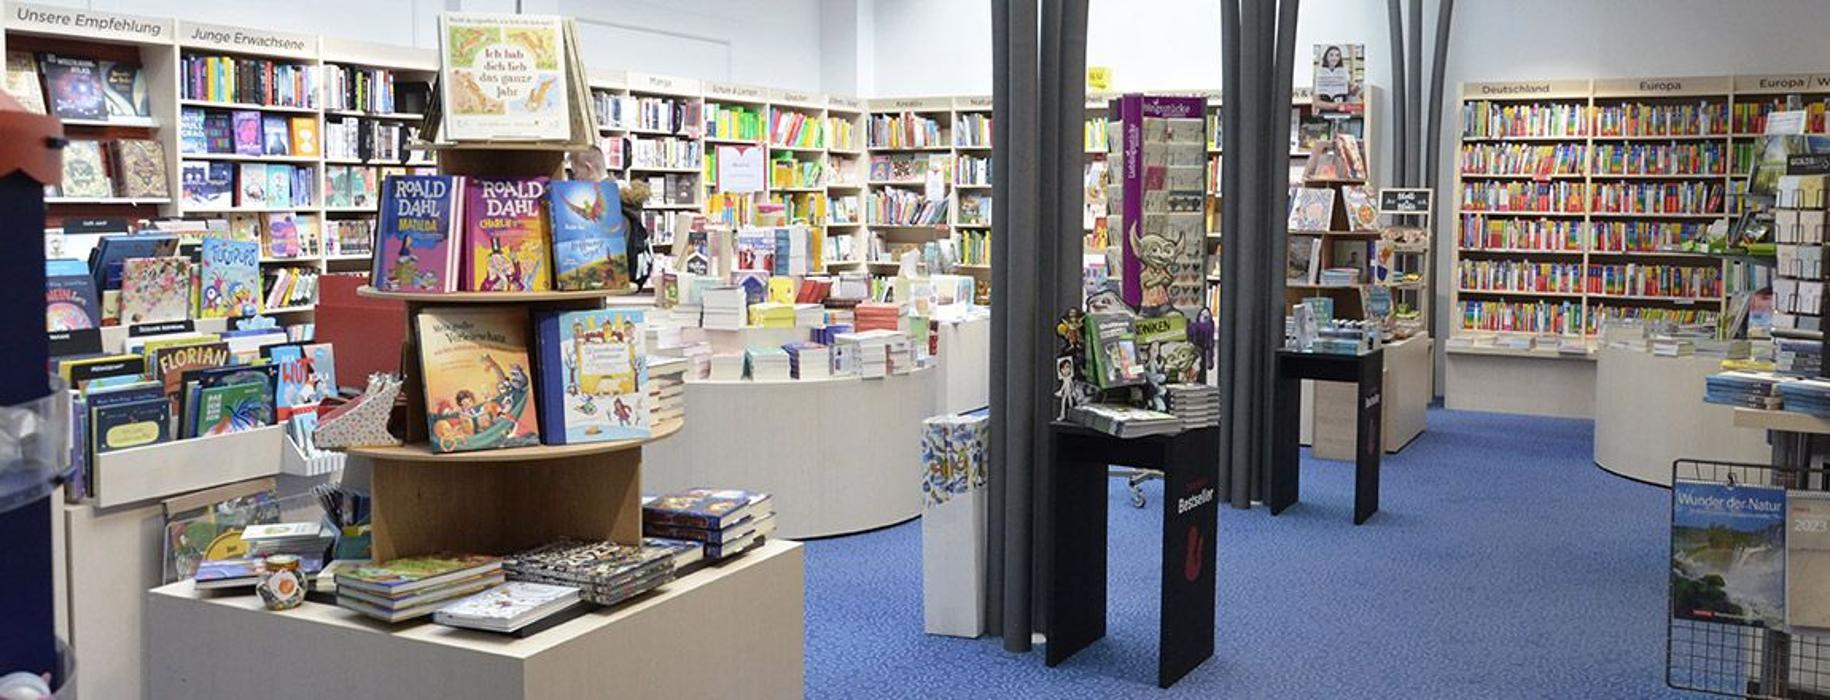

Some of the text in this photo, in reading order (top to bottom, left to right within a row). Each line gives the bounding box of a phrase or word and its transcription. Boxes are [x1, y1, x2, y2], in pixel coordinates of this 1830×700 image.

[17, 7, 162, 37] Unsere Empfehlung
[191, 28, 305, 50] Junge Erwachsene
[485, 48, 524, 59] Ich hab
[483, 61, 527, 71] dich lieb
[479, 72, 532, 85] das ganze
[1639, 80, 1682, 92] Europa
[1759, 77, 1804, 90] Europa
[496, 86, 518, 98] Jahr
[1481, 84, 1550, 95] Deutschland
[395, 180, 446, 199] ROALD
[482, 180, 544, 199] ROALD
[397, 199, 441, 217] DAHL
[487, 199, 539, 217] DAHL
[159, 346, 228, 374] FLORIAN
[1178, 488, 1214, 515] Bestseller
[1678, 492, 1724, 508] Wunder
[1726, 496, 1746, 510] der
[1748, 498, 1781, 512] Natur
[1794, 519, 1827, 532] 2023
